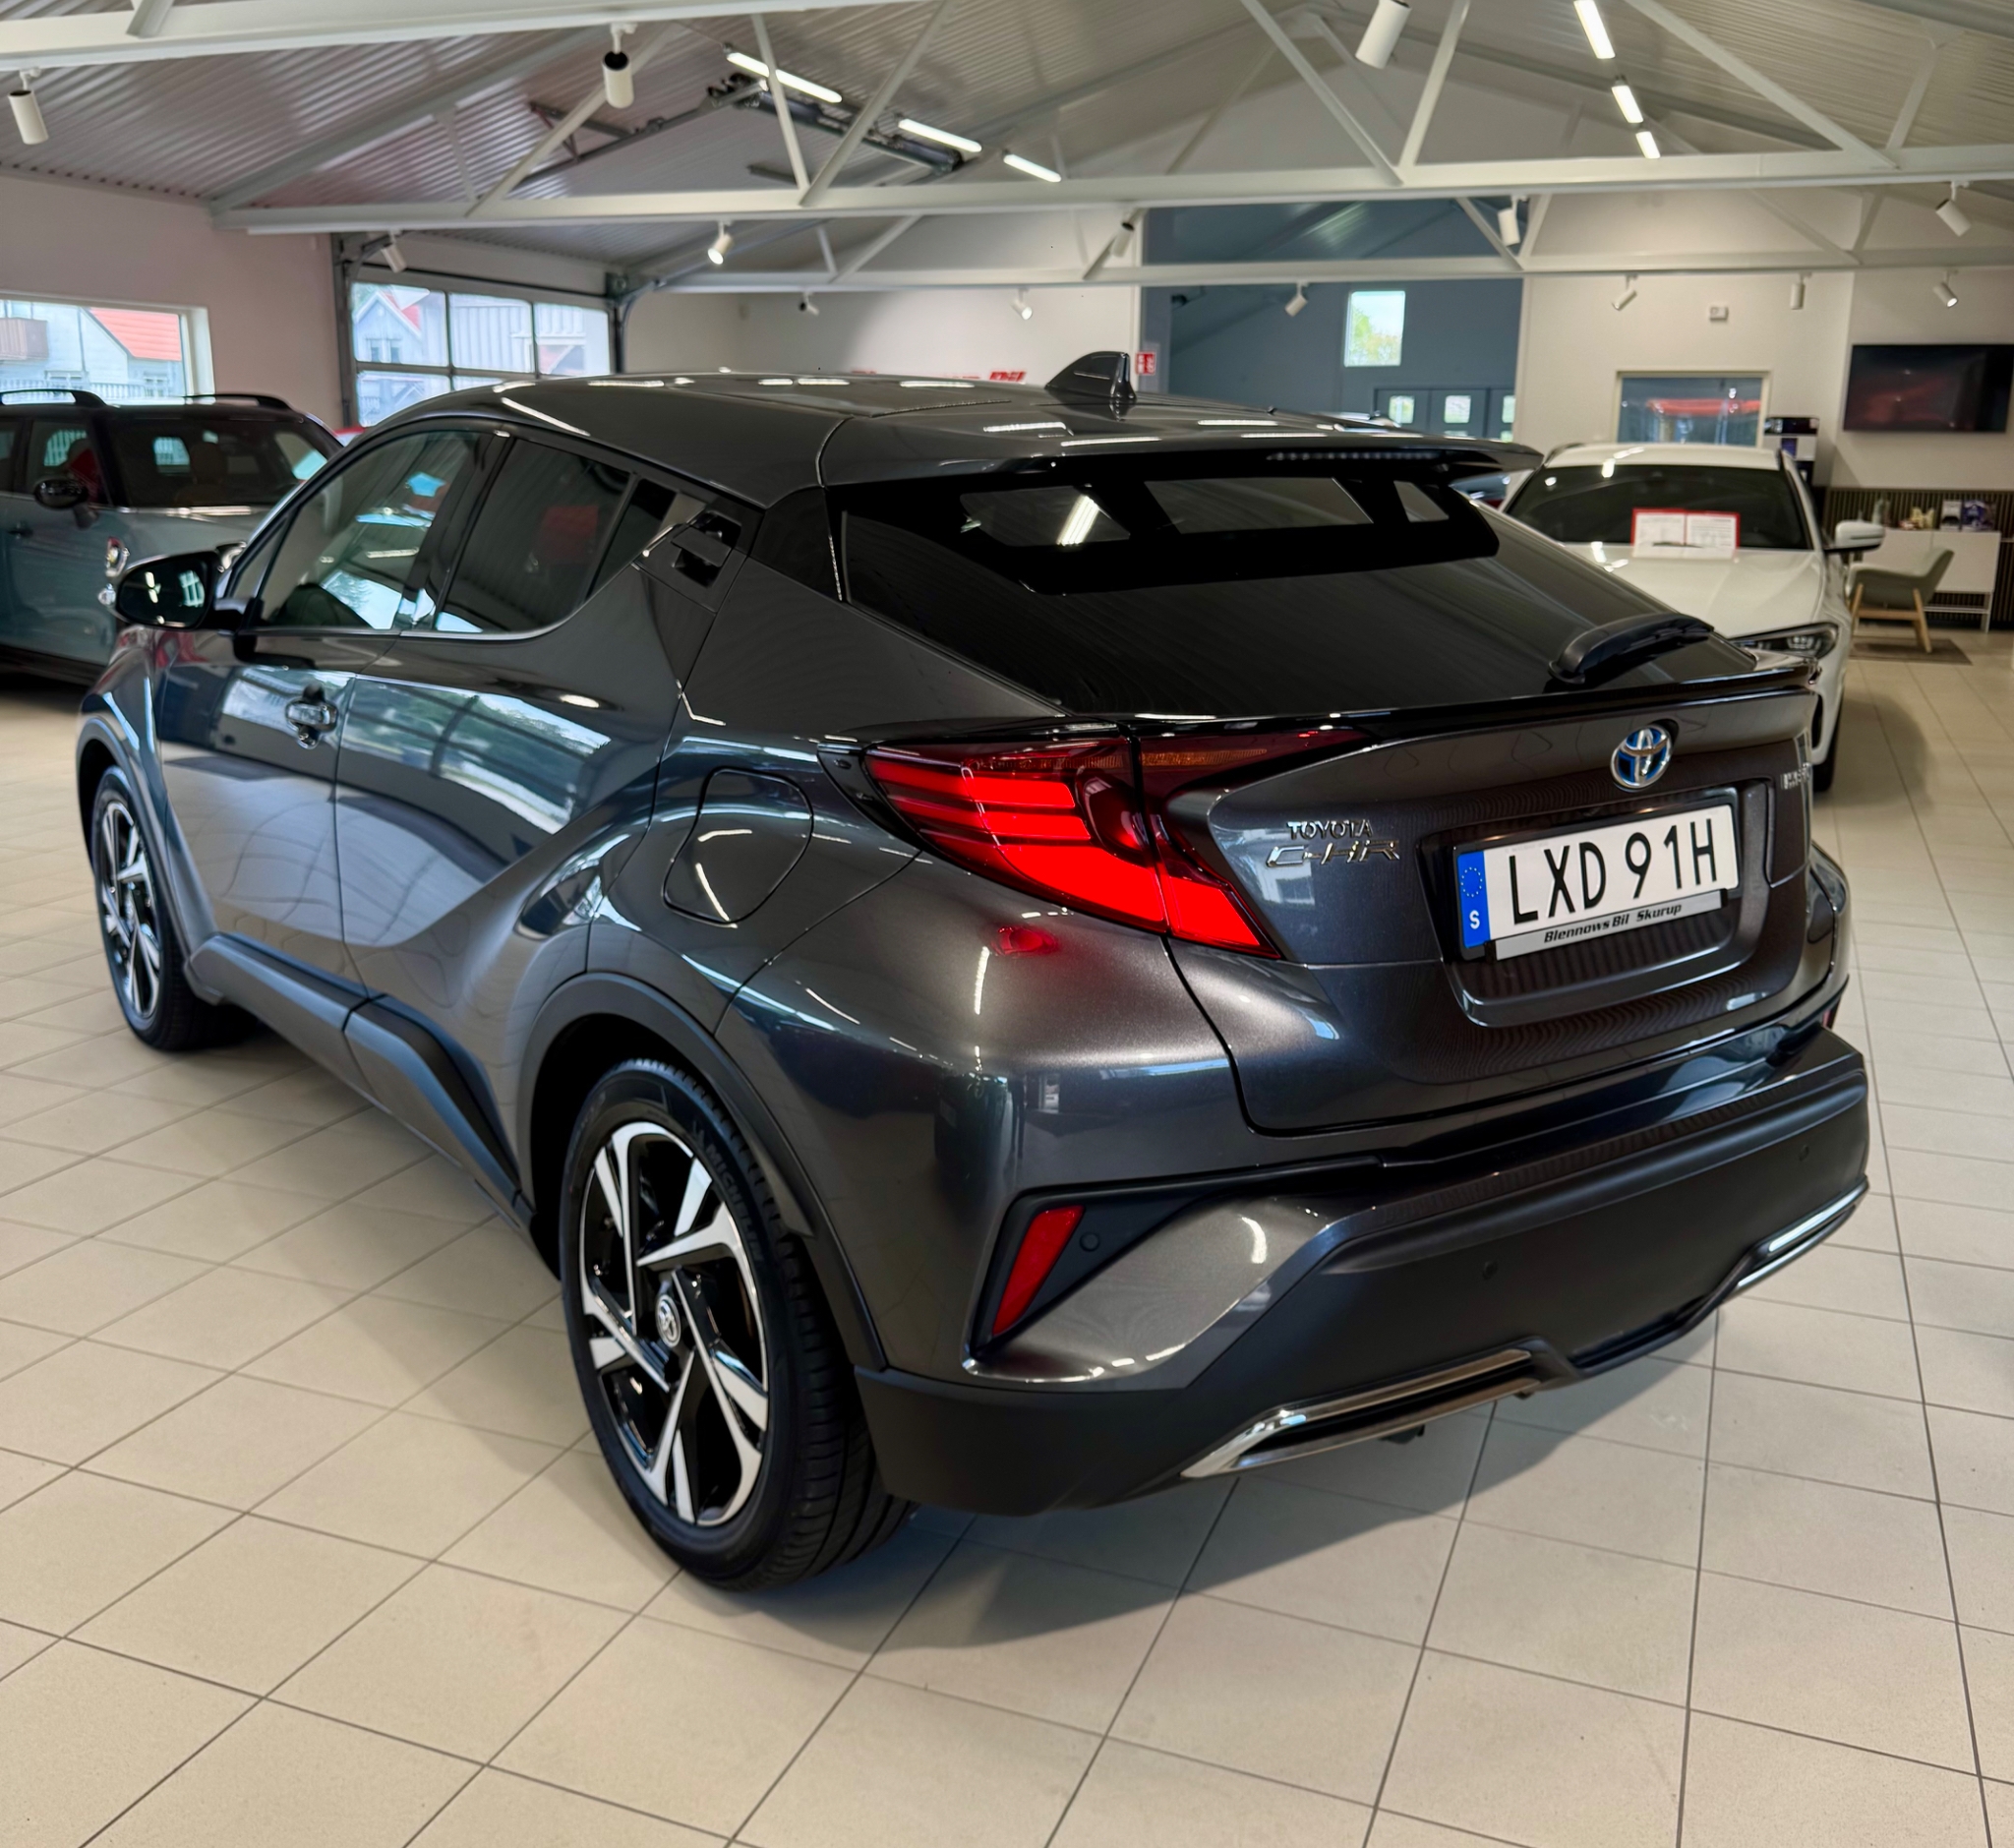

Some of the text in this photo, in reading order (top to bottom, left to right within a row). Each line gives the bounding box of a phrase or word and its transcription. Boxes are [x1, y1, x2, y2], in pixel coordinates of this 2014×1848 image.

[1286, 818, 1374, 840] TOYOTA
[1266, 839, 1400, 867] C-HR
[1508, 817, 1718, 925] LXD 91H
[1468, 909, 1481, 930] S
[1543, 902, 1683, 944] Blennows Bil Skurup
